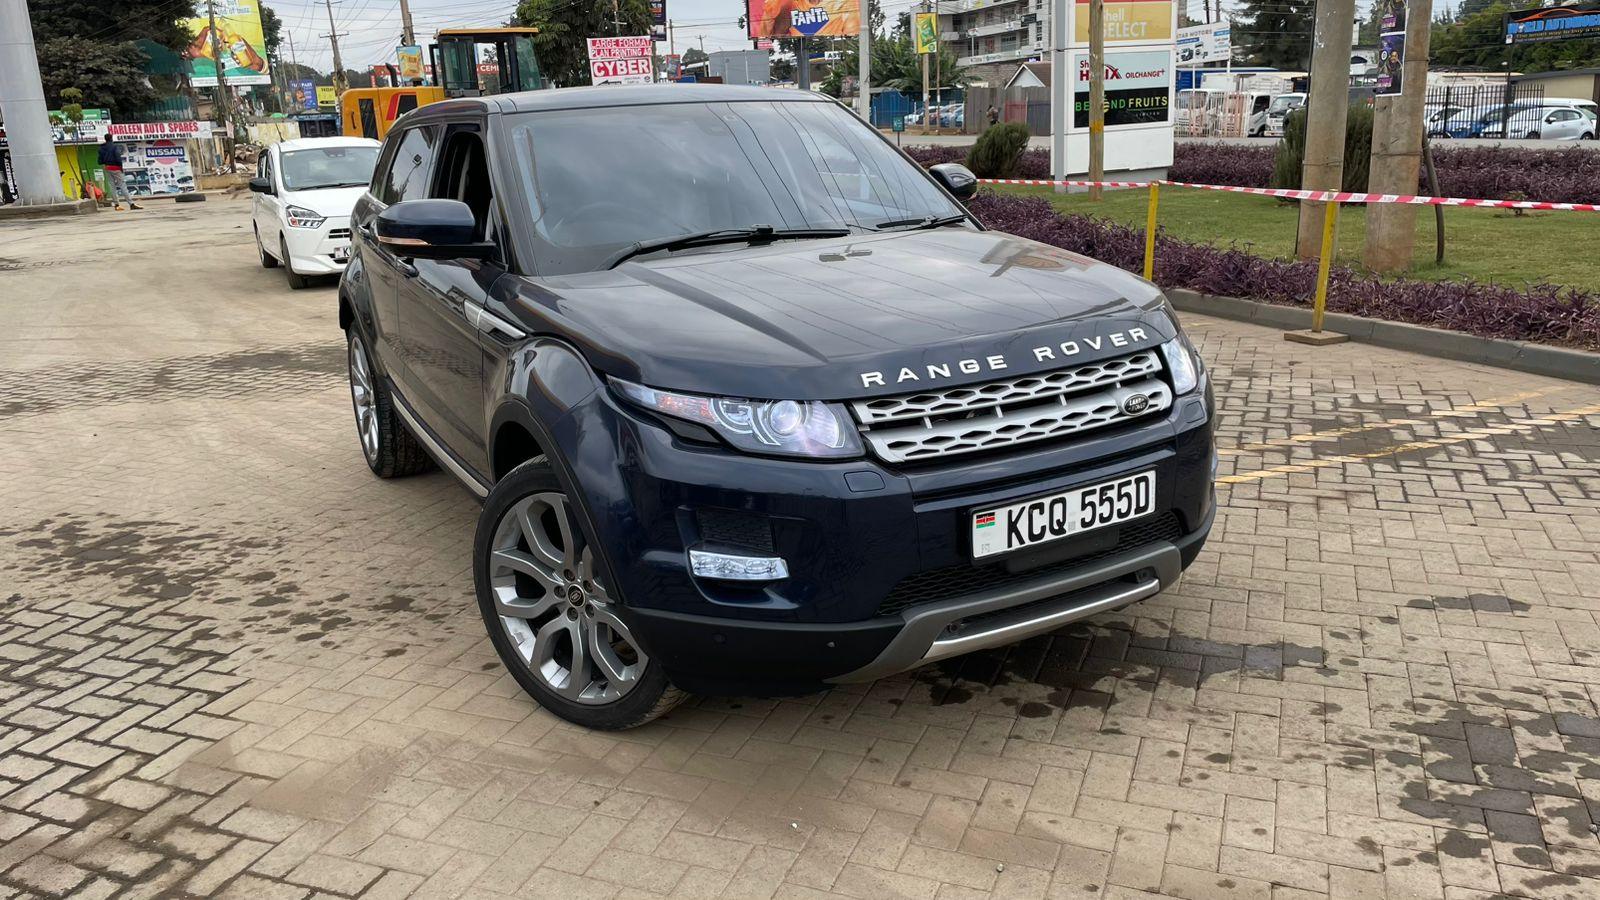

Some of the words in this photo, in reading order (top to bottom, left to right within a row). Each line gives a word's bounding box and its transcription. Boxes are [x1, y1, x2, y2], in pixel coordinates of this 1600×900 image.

[790, 8, 828, 25] FANTA
[1104, 7, 1125, 22] hell
[590, 39, 617, 48] LARGE
[619, 38, 652, 48] FORMAT
[591, 48, 610, 57] PLAN
[611, 48, 642, 57] PRINTING
[593, 59, 650, 77] CYBER
[1080, 66, 1121, 81] HIX
[1075, 98, 1126, 113] BEOND
[1128, 96, 1168, 108] FRUITS
[107, 123, 142, 135] HARLEEN
[144, 122, 166, 134] AUTO
[168, 121, 199, 132] SPARES
[147, 147, 184, 157] NISSAN
[860, 355, 1008, 388] RANGE
[1032, 327, 1149, 362] ROVER
[1007, 496, 1067, 549] KCQ
[1080, 475, 1150, 529] 555D
